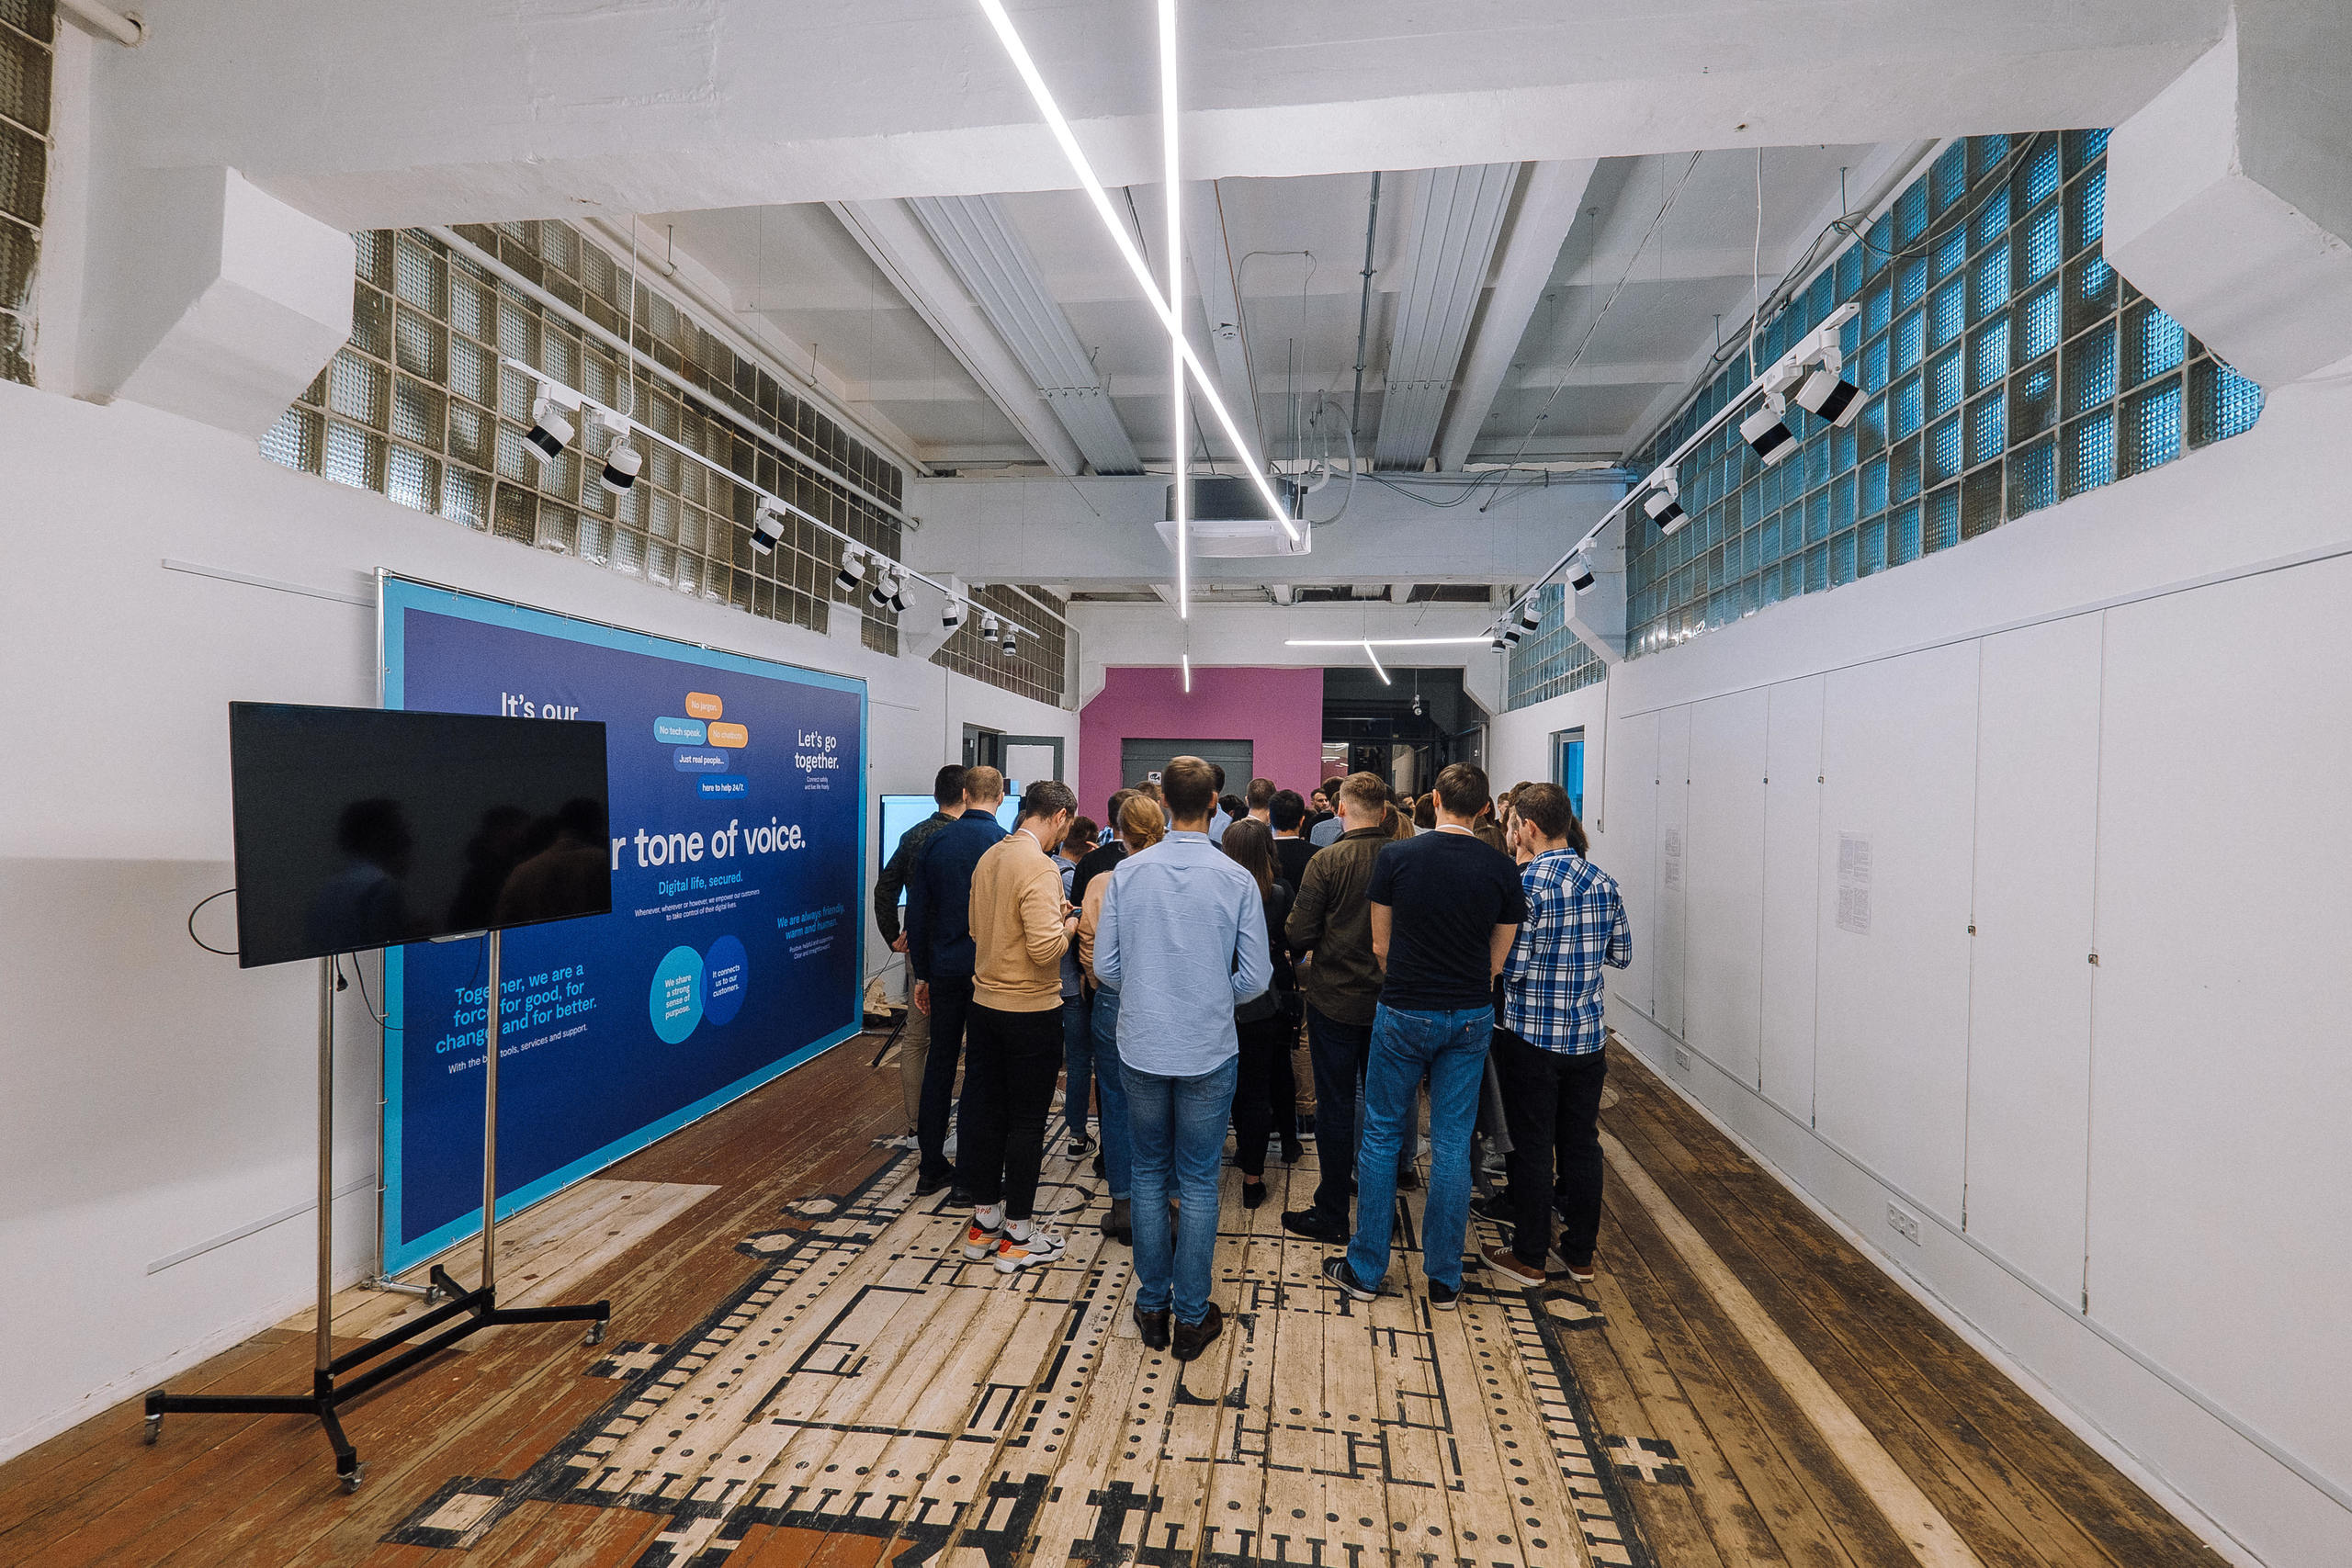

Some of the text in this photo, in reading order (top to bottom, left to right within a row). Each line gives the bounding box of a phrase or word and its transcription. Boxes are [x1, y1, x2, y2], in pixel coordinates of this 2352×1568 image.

[502, 692, 579, 721] It's our
[692, 700, 700, 709] No
[660, 726, 702, 739] No tech speak.
[713, 729, 721, 739] No
[798, 729, 837, 752] Let's go
[679, 755, 692, 763] Just
[693, 755, 703, 763] real
[795, 751, 839, 773] together.
[703, 784, 714, 792] here
[721, 784, 732, 793] help
[634, 829, 704, 867] tone
[711, 819, 738, 859] of
[744, 816, 806, 855] voice.
[659, 871, 743, 897] Digital life, secured.
[716, 894, 733, 902] empower
[672, 912, 682, 920] take
[683, 908, 698, 919] control
[699, 907, 705, 915] of
[706, 905, 714, 913] their
[715, 902, 727, 912] digital
[777, 917, 788, 929] We
[789, 916, 799, 925] are
[801, 910, 821, 921] always
[786, 928, 803, 940] warm
[805, 922, 817, 934] and
[529, 973, 548, 987] we
[551, 966, 572, 982] are
[576, 964, 584, 976] a
[713, 964, 741, 978] It connects
[729, 975, 738, 983] our
[665, 975, 692, 987] We share
[672, 985, 690, 997] strong
[713, 984, 740, 998] customers.
[454, 982, 584, 1027] forc for good, for
[666, 992, 690, 1009] sense of
[502, 1013, 528, 1035] and
[532, 1009, 553, 1026] for
[556, 997, 597, 1020] better.
[665, 1005, 691, 1021] purpose.
[448, 1061, 467, 1074] With
[468, 1057, 481, 1068] the
[500, 1046, 519, 1057] tools,
[521, 1037, 548, 1051] services
[549, 1030, 561, 1042] and
[562, 1023, 588, 1039] support.
